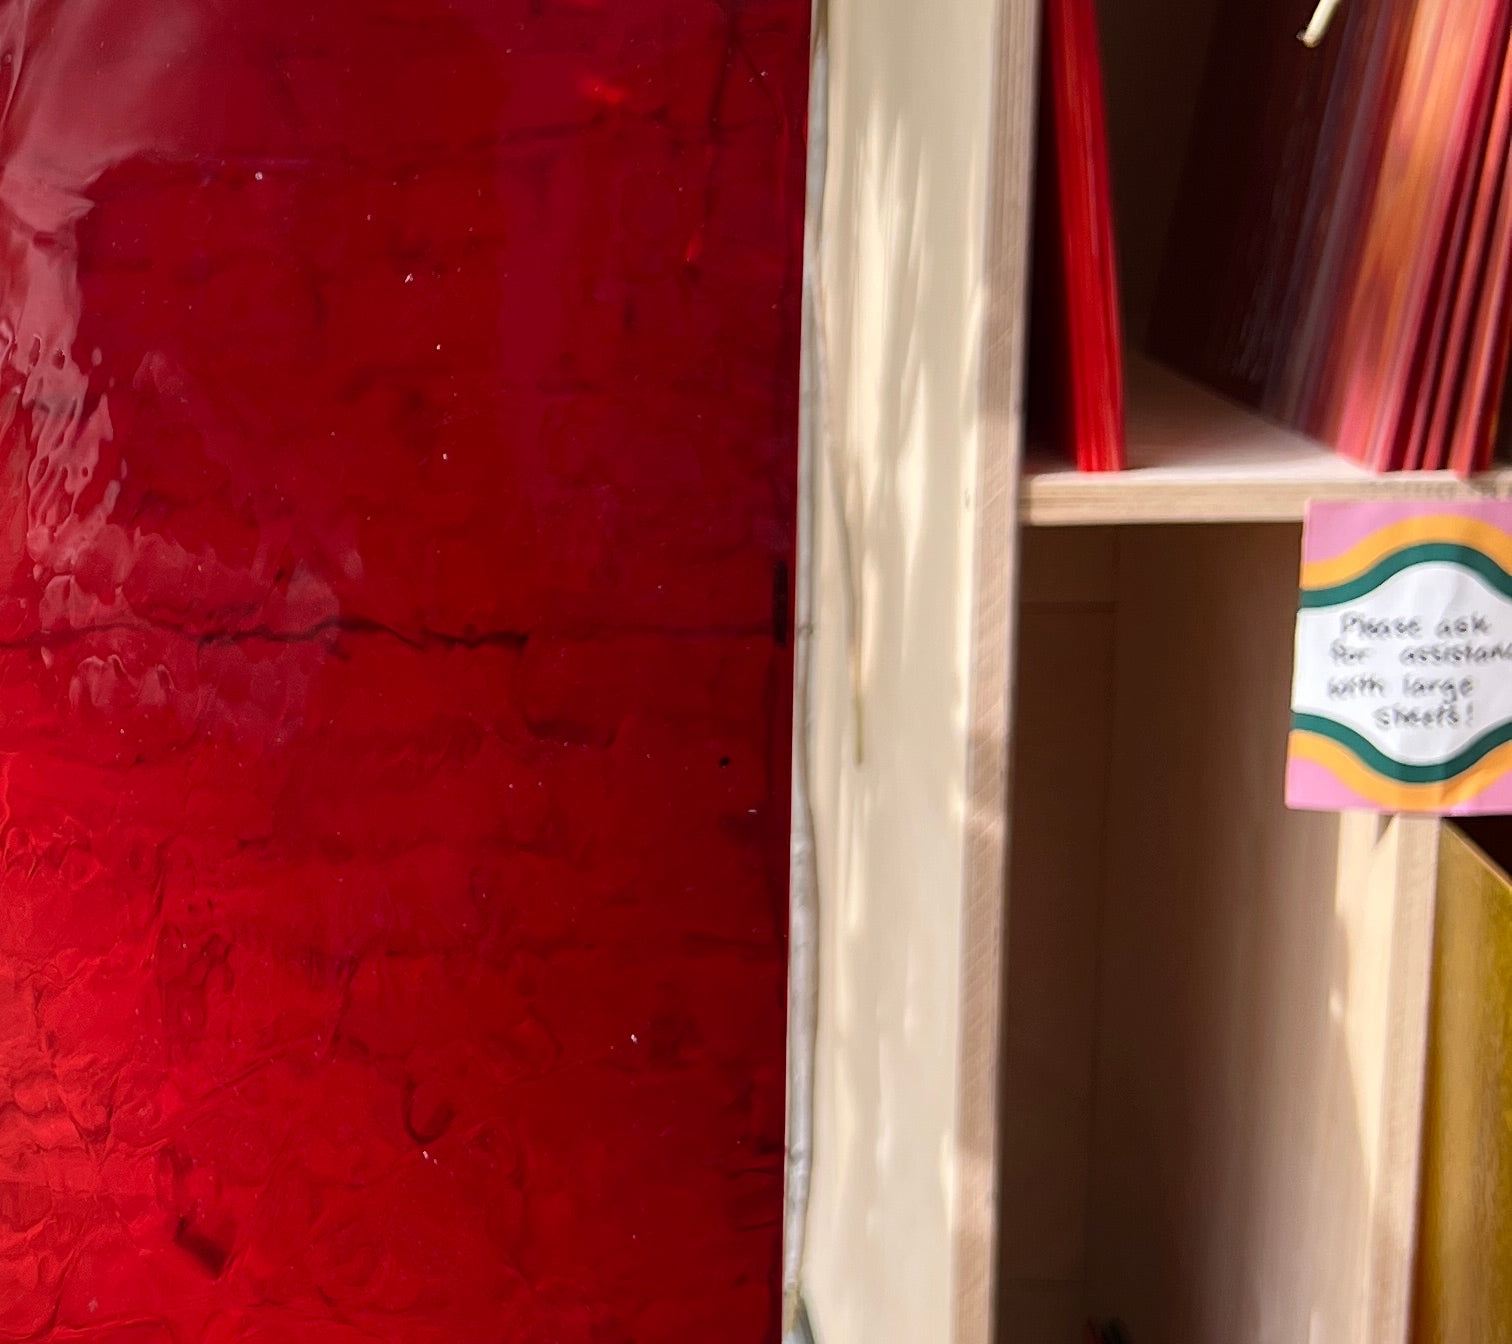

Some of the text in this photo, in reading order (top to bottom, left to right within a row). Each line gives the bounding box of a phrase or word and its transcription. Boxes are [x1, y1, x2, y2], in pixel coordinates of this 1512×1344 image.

[1341, 611, 1491, 639] Please ask
[1330, 639, 1372, 665] for
[1328, 672, 1474, 704] with large
